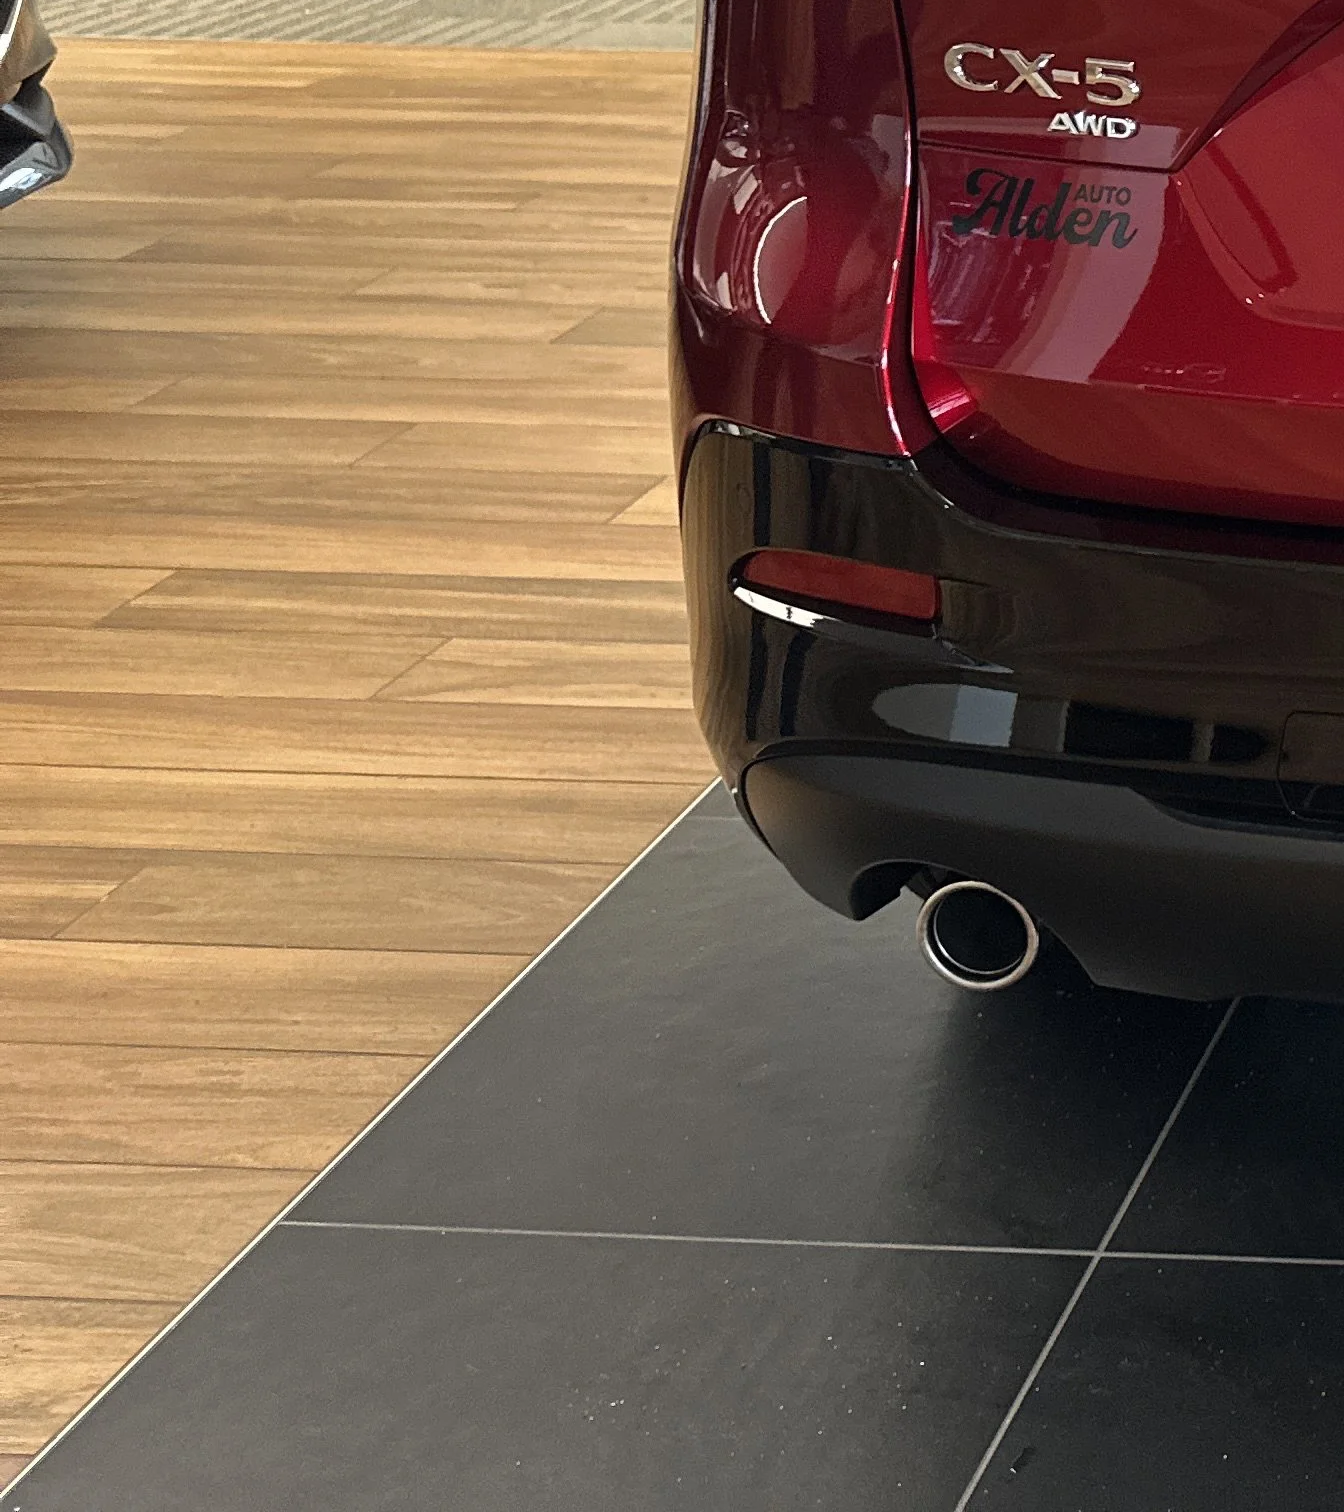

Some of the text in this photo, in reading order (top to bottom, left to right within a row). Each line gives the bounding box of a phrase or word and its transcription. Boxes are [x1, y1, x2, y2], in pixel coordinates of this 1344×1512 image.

[944, 42, 1141, 107] CX-5
[1047, 110, 1137, 139] AWD
[952, 167, 1138, 249] Alden
[1074, 184, 1132, 205] AUTO
